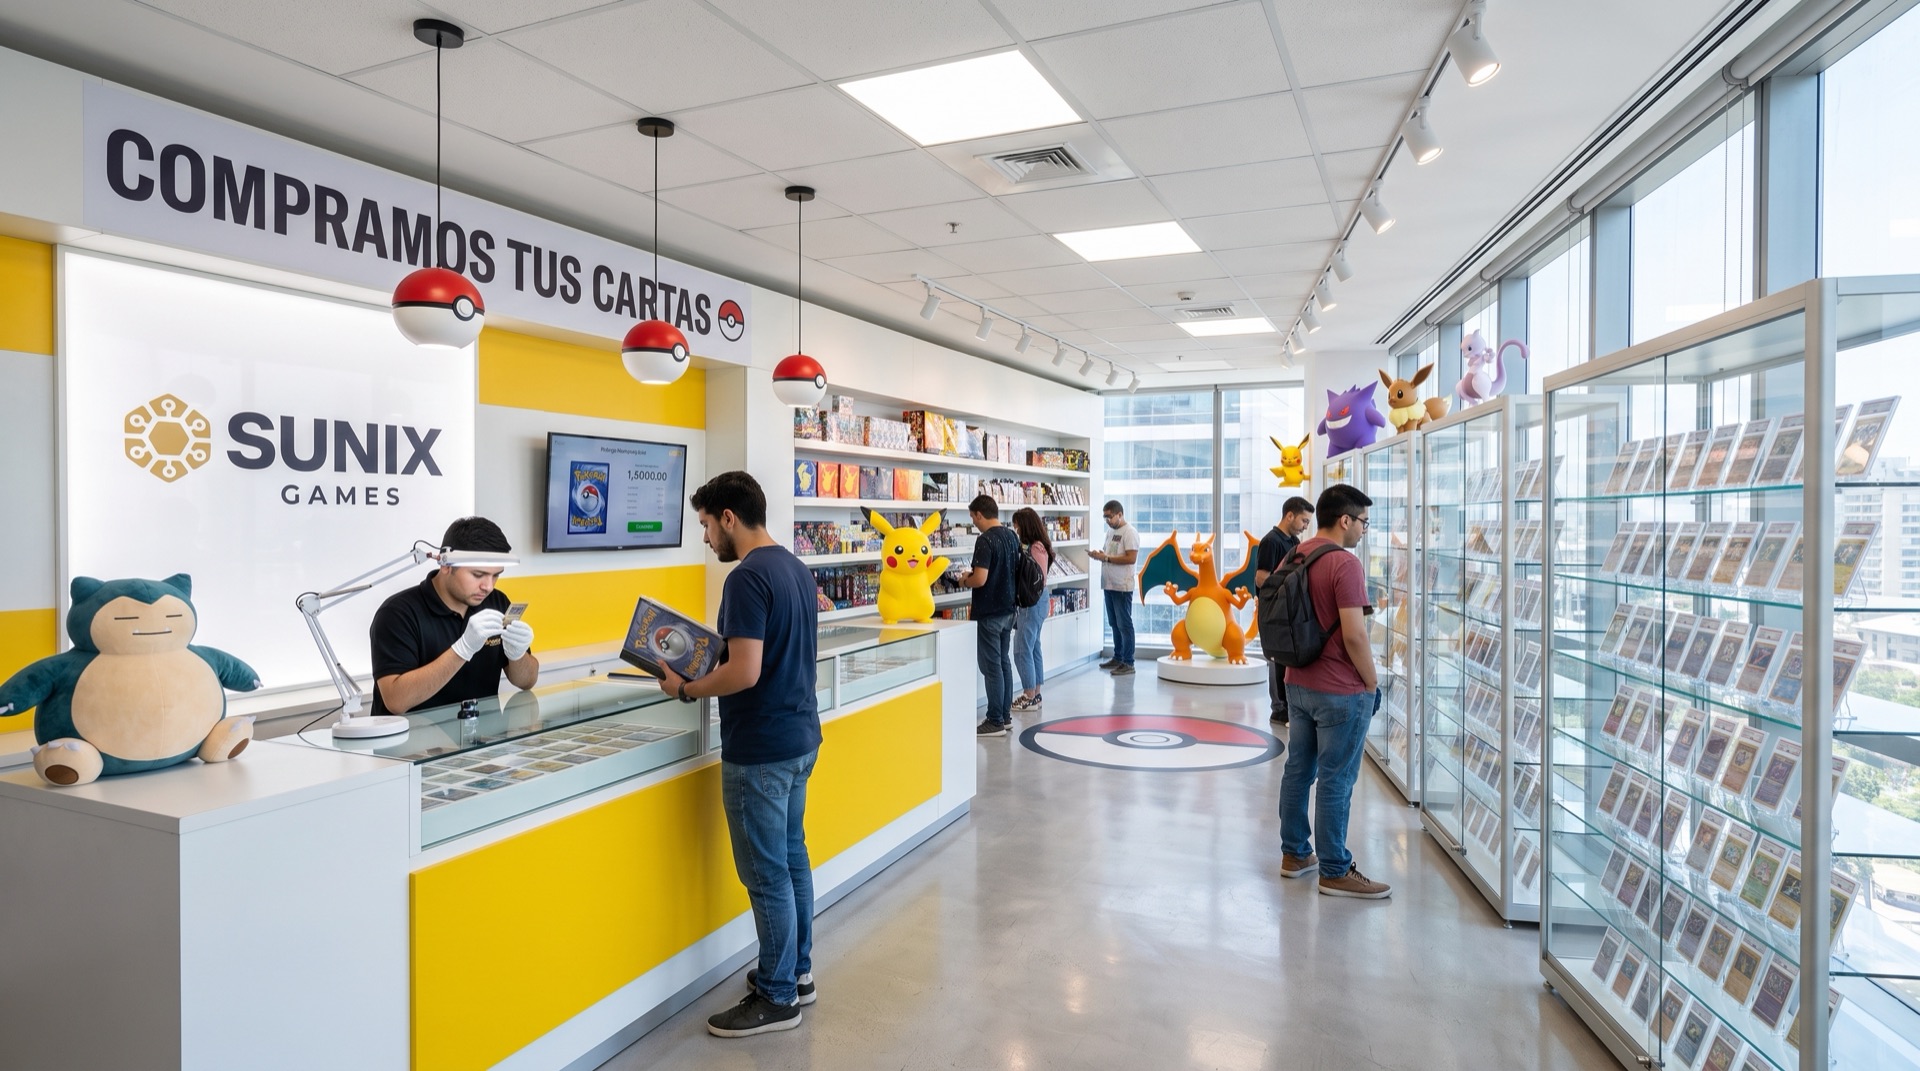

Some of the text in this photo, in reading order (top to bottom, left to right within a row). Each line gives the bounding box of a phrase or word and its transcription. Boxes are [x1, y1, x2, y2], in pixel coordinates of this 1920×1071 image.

[106, 128, 711, 336] COMPRAMOS TUS CARTAS
[226, 411, 443, 477] SUNIX
[281, 484, 401, 506] GAMES
[627, 470, 668, 481] 1,5000.00
